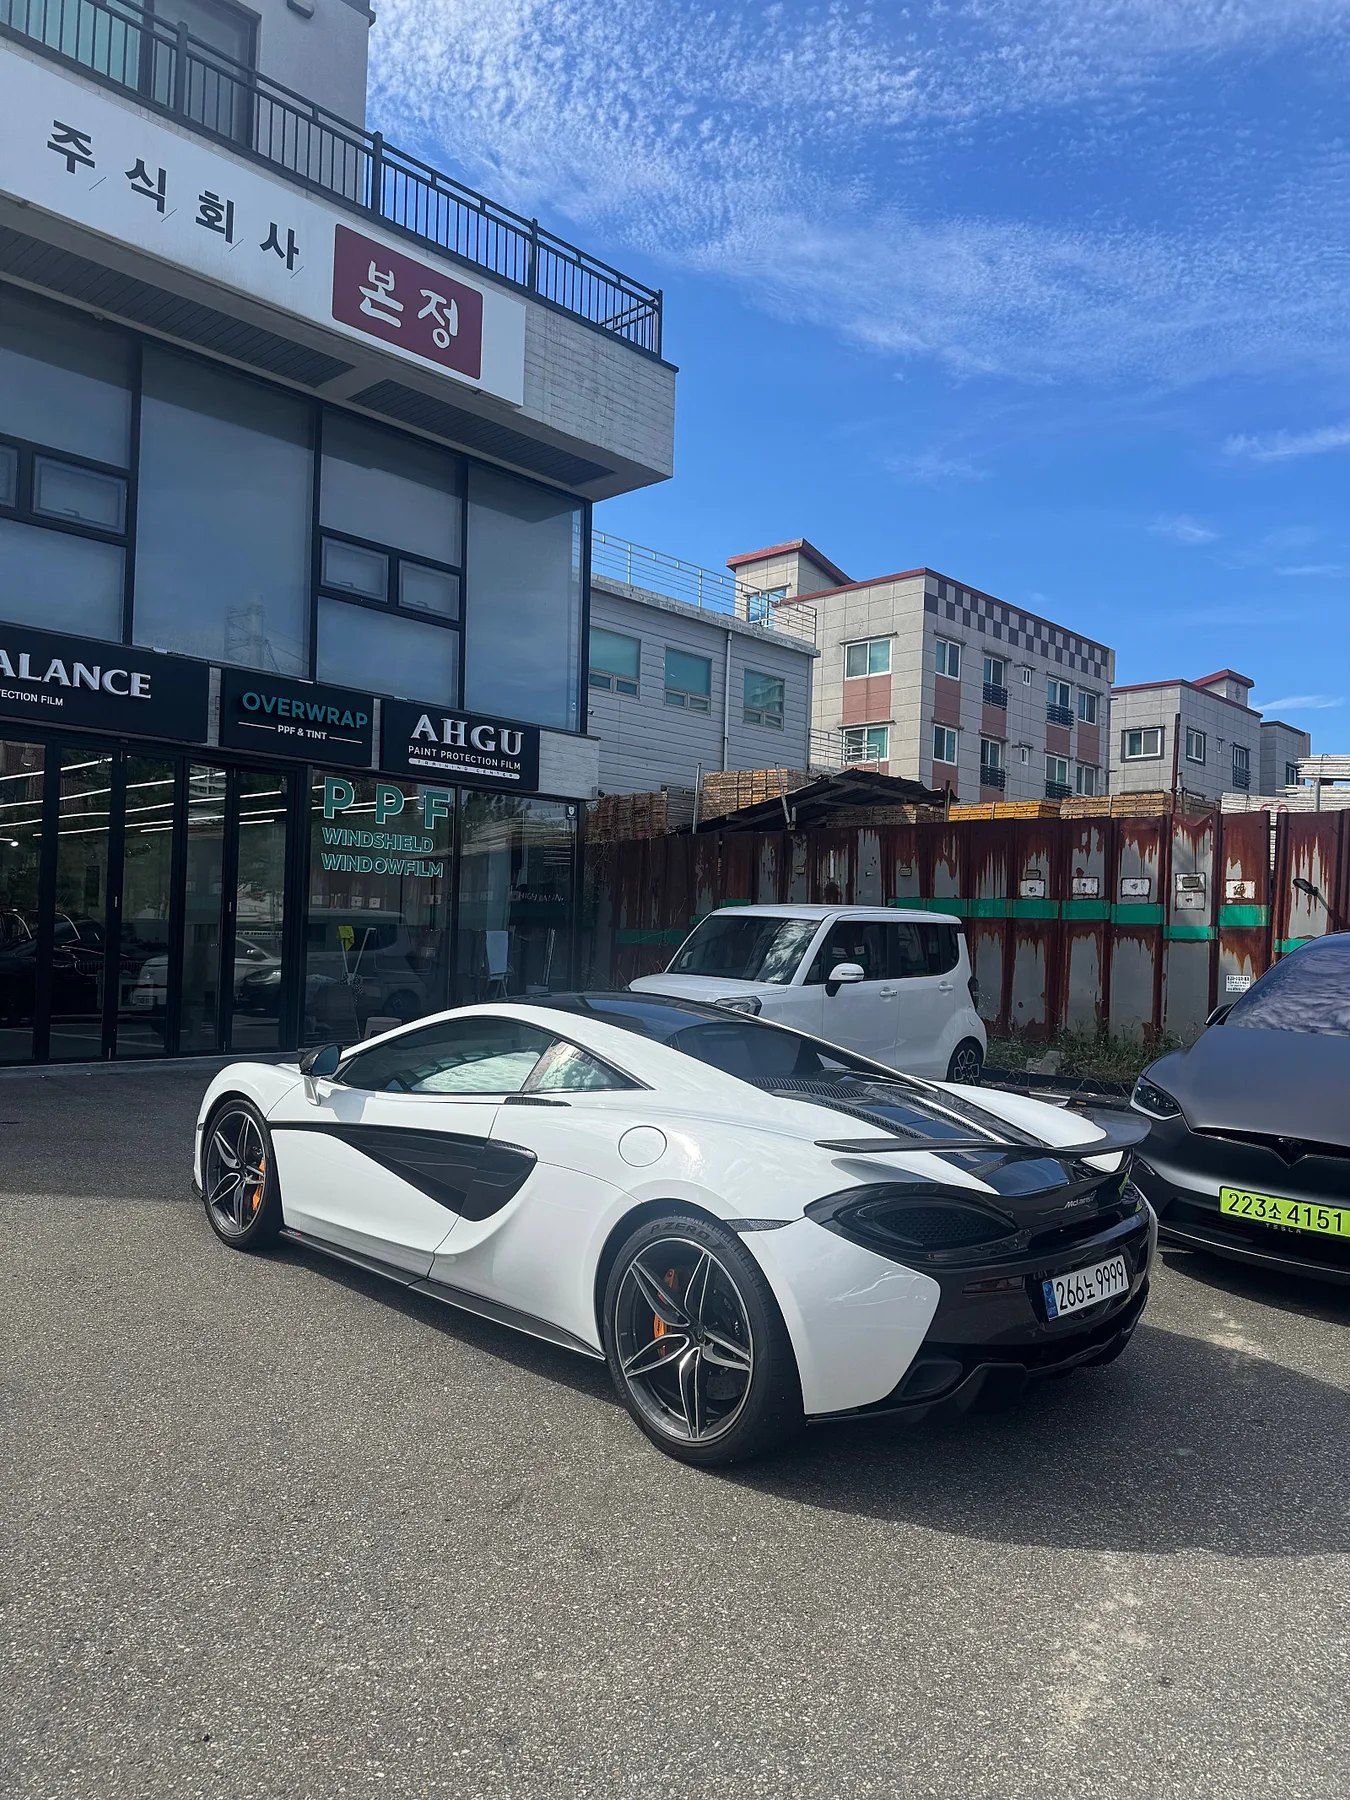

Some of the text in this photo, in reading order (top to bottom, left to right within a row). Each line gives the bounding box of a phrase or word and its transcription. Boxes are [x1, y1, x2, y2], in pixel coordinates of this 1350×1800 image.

[47, 120, 459, 349] 주식회사 본정
[0, 688, 64, 706] ECTION FILM
[242, 691, 368, 728] OVERWRAP
[277, 724, 328, 740] PPF & TINT
[410, 714, 525, 756] AHGU
[408, 745, 521, 771] PAINT PROTECTION FILM
[321, 826, 434, 853] WINDSHIELD
[320, 852, 444, 878] WINDOWFILM
[1228, 1193, 1342, 1233] 223소 4151
[664, 1221, 711, 1241] ZERO
[1265, 1222, 1302, 1235] TESLA
[1056, 1260, 1124, 1311] 266노 9999
